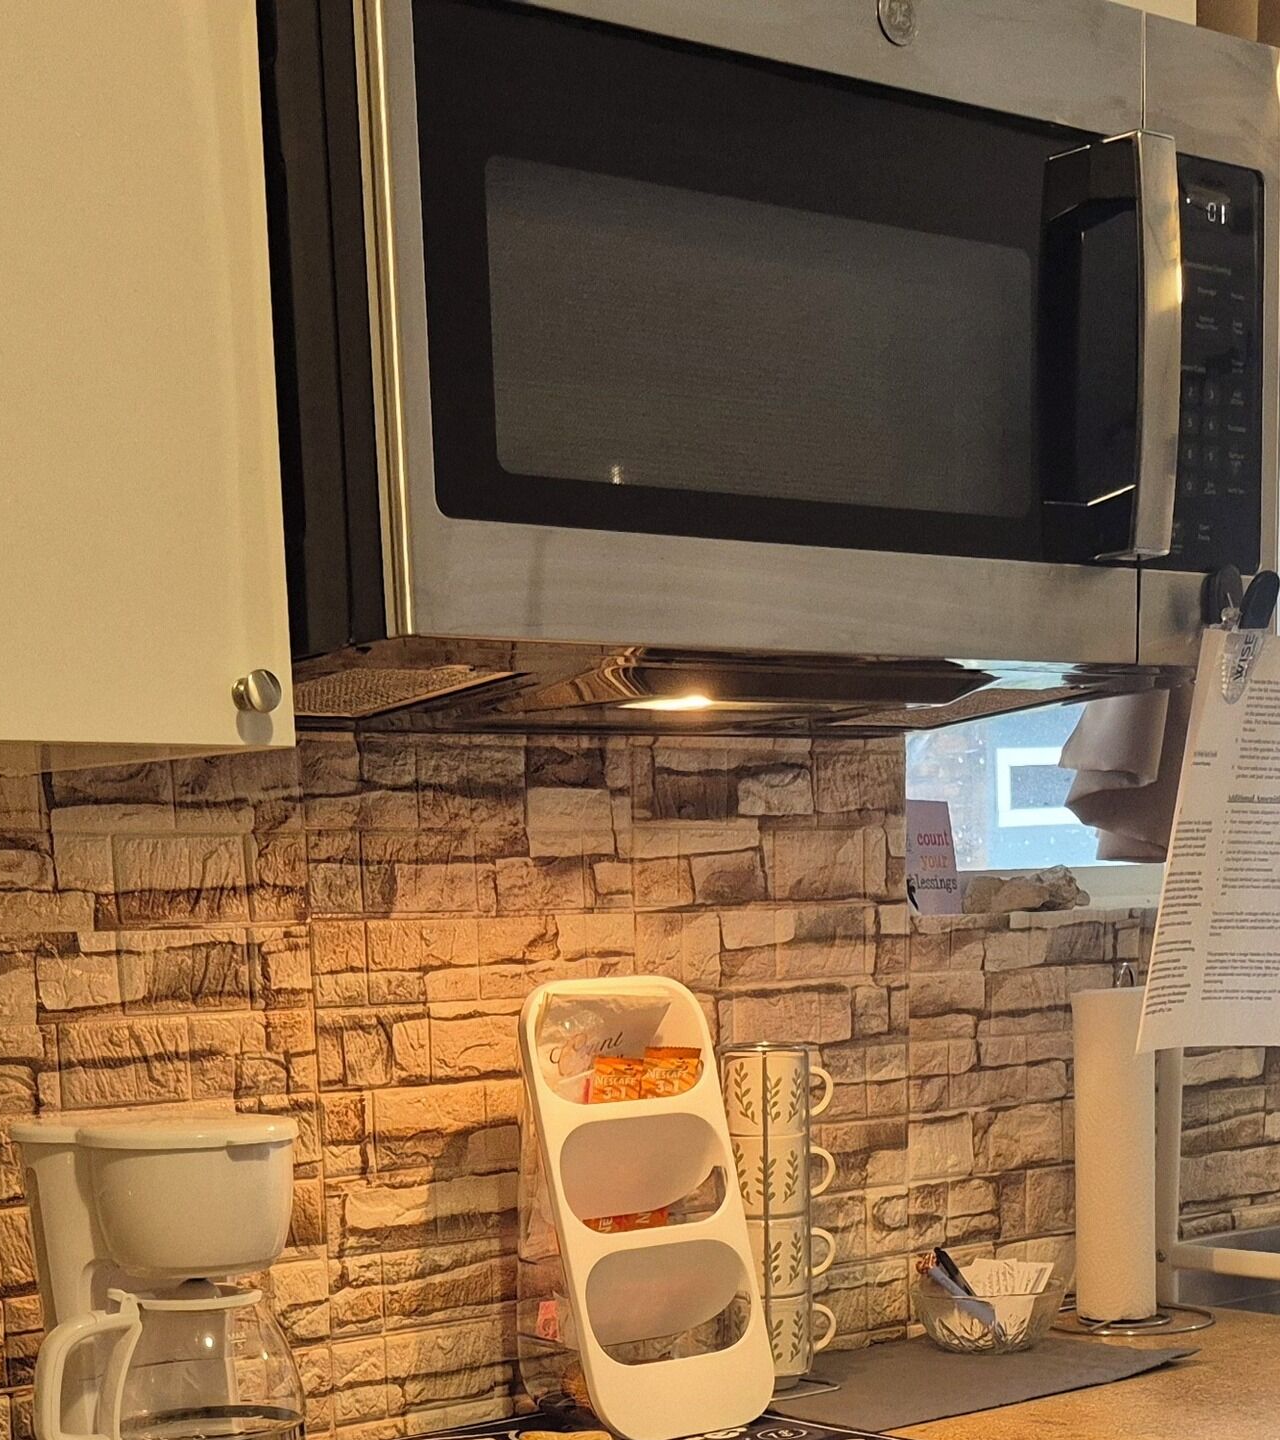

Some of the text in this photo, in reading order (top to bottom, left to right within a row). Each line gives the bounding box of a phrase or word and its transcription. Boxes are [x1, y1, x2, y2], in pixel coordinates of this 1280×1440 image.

[1233, 633, 1256, 681] WISE
[917, 830, 950, 846] count
[920, 855, 949, 871] your
